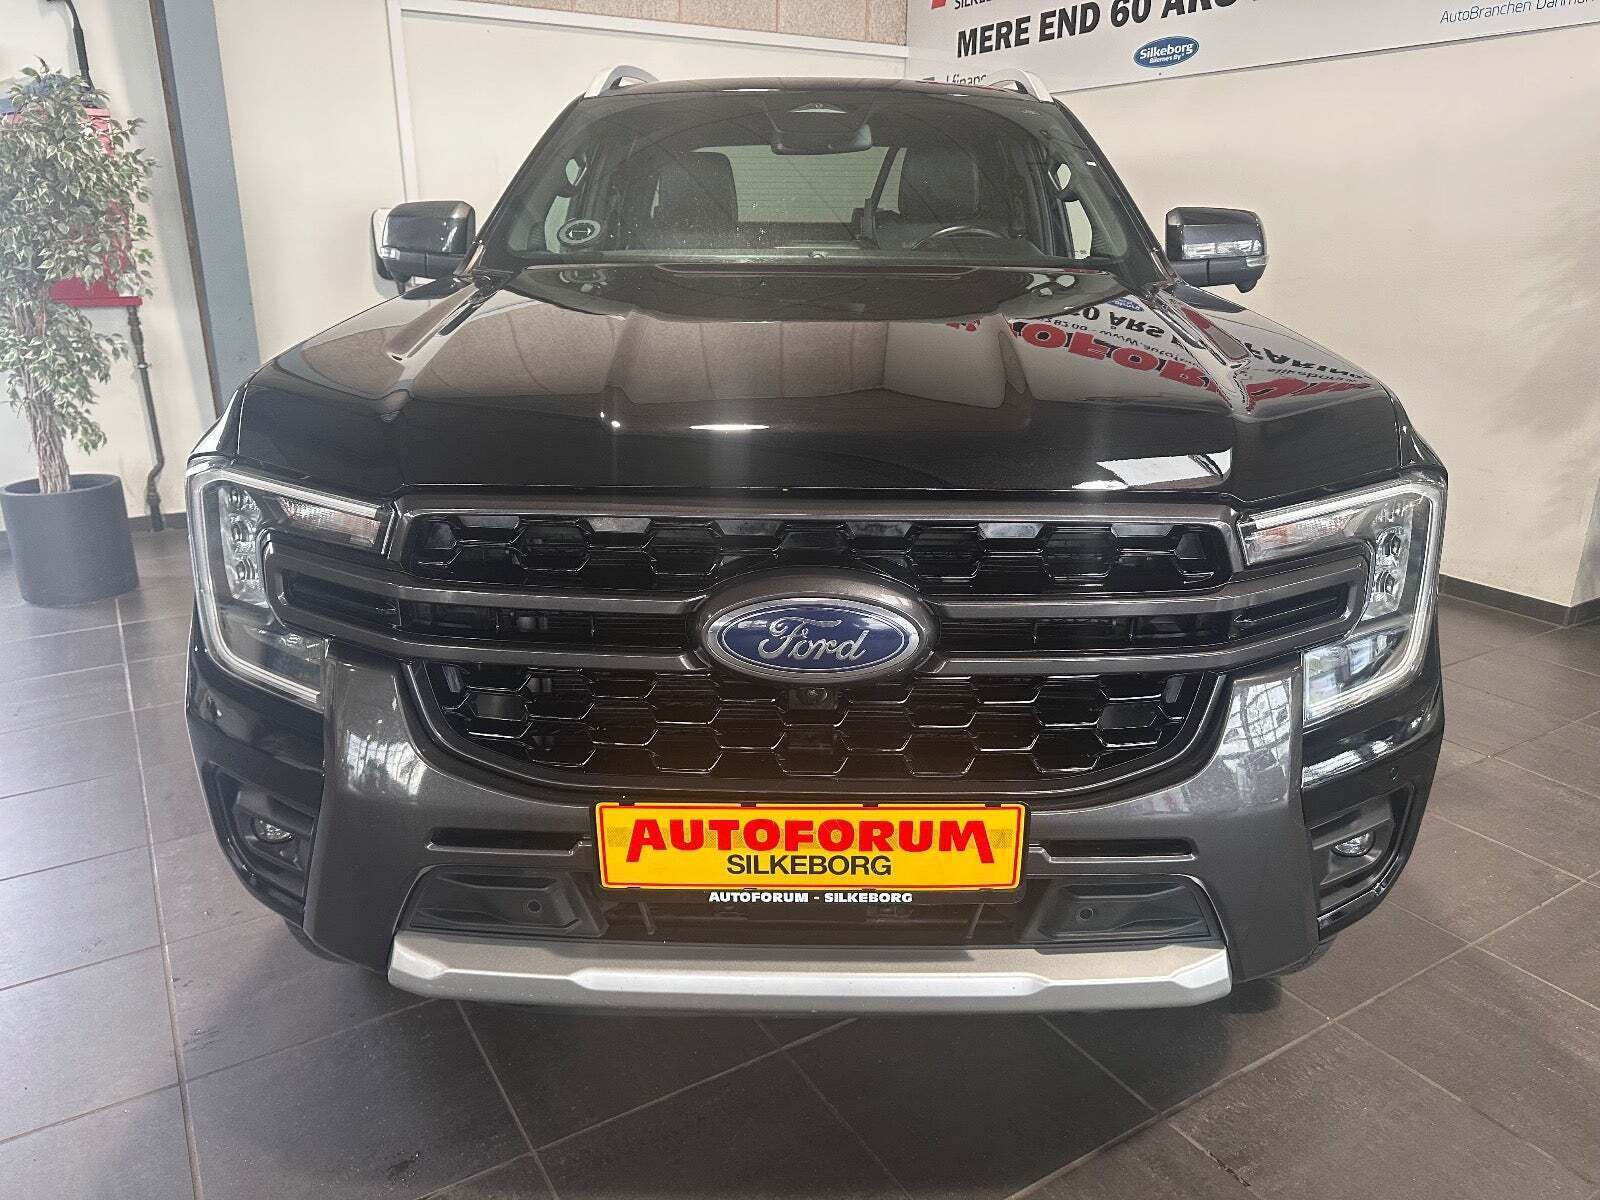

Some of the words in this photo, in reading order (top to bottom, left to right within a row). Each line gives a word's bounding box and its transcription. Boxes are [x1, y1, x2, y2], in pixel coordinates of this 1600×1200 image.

[1440, 1, 1531, 24] AutoBranchen
[957, 16, 1031, 58] MERE
[1038, 1, 1100, 42] END
[1110, 0, 1151, 28] 60
[1139, 43, 1195, 59] Silkeborg
[757, 616, 870, 661] Ford
[626, 818, 995, 864] AUTOFORUM
[726, 853, 892, 876] SILKEBORG
[708, 891, 809, 903] AUTOFORUM
[824, 892, 913, 904] SILKEBORG
